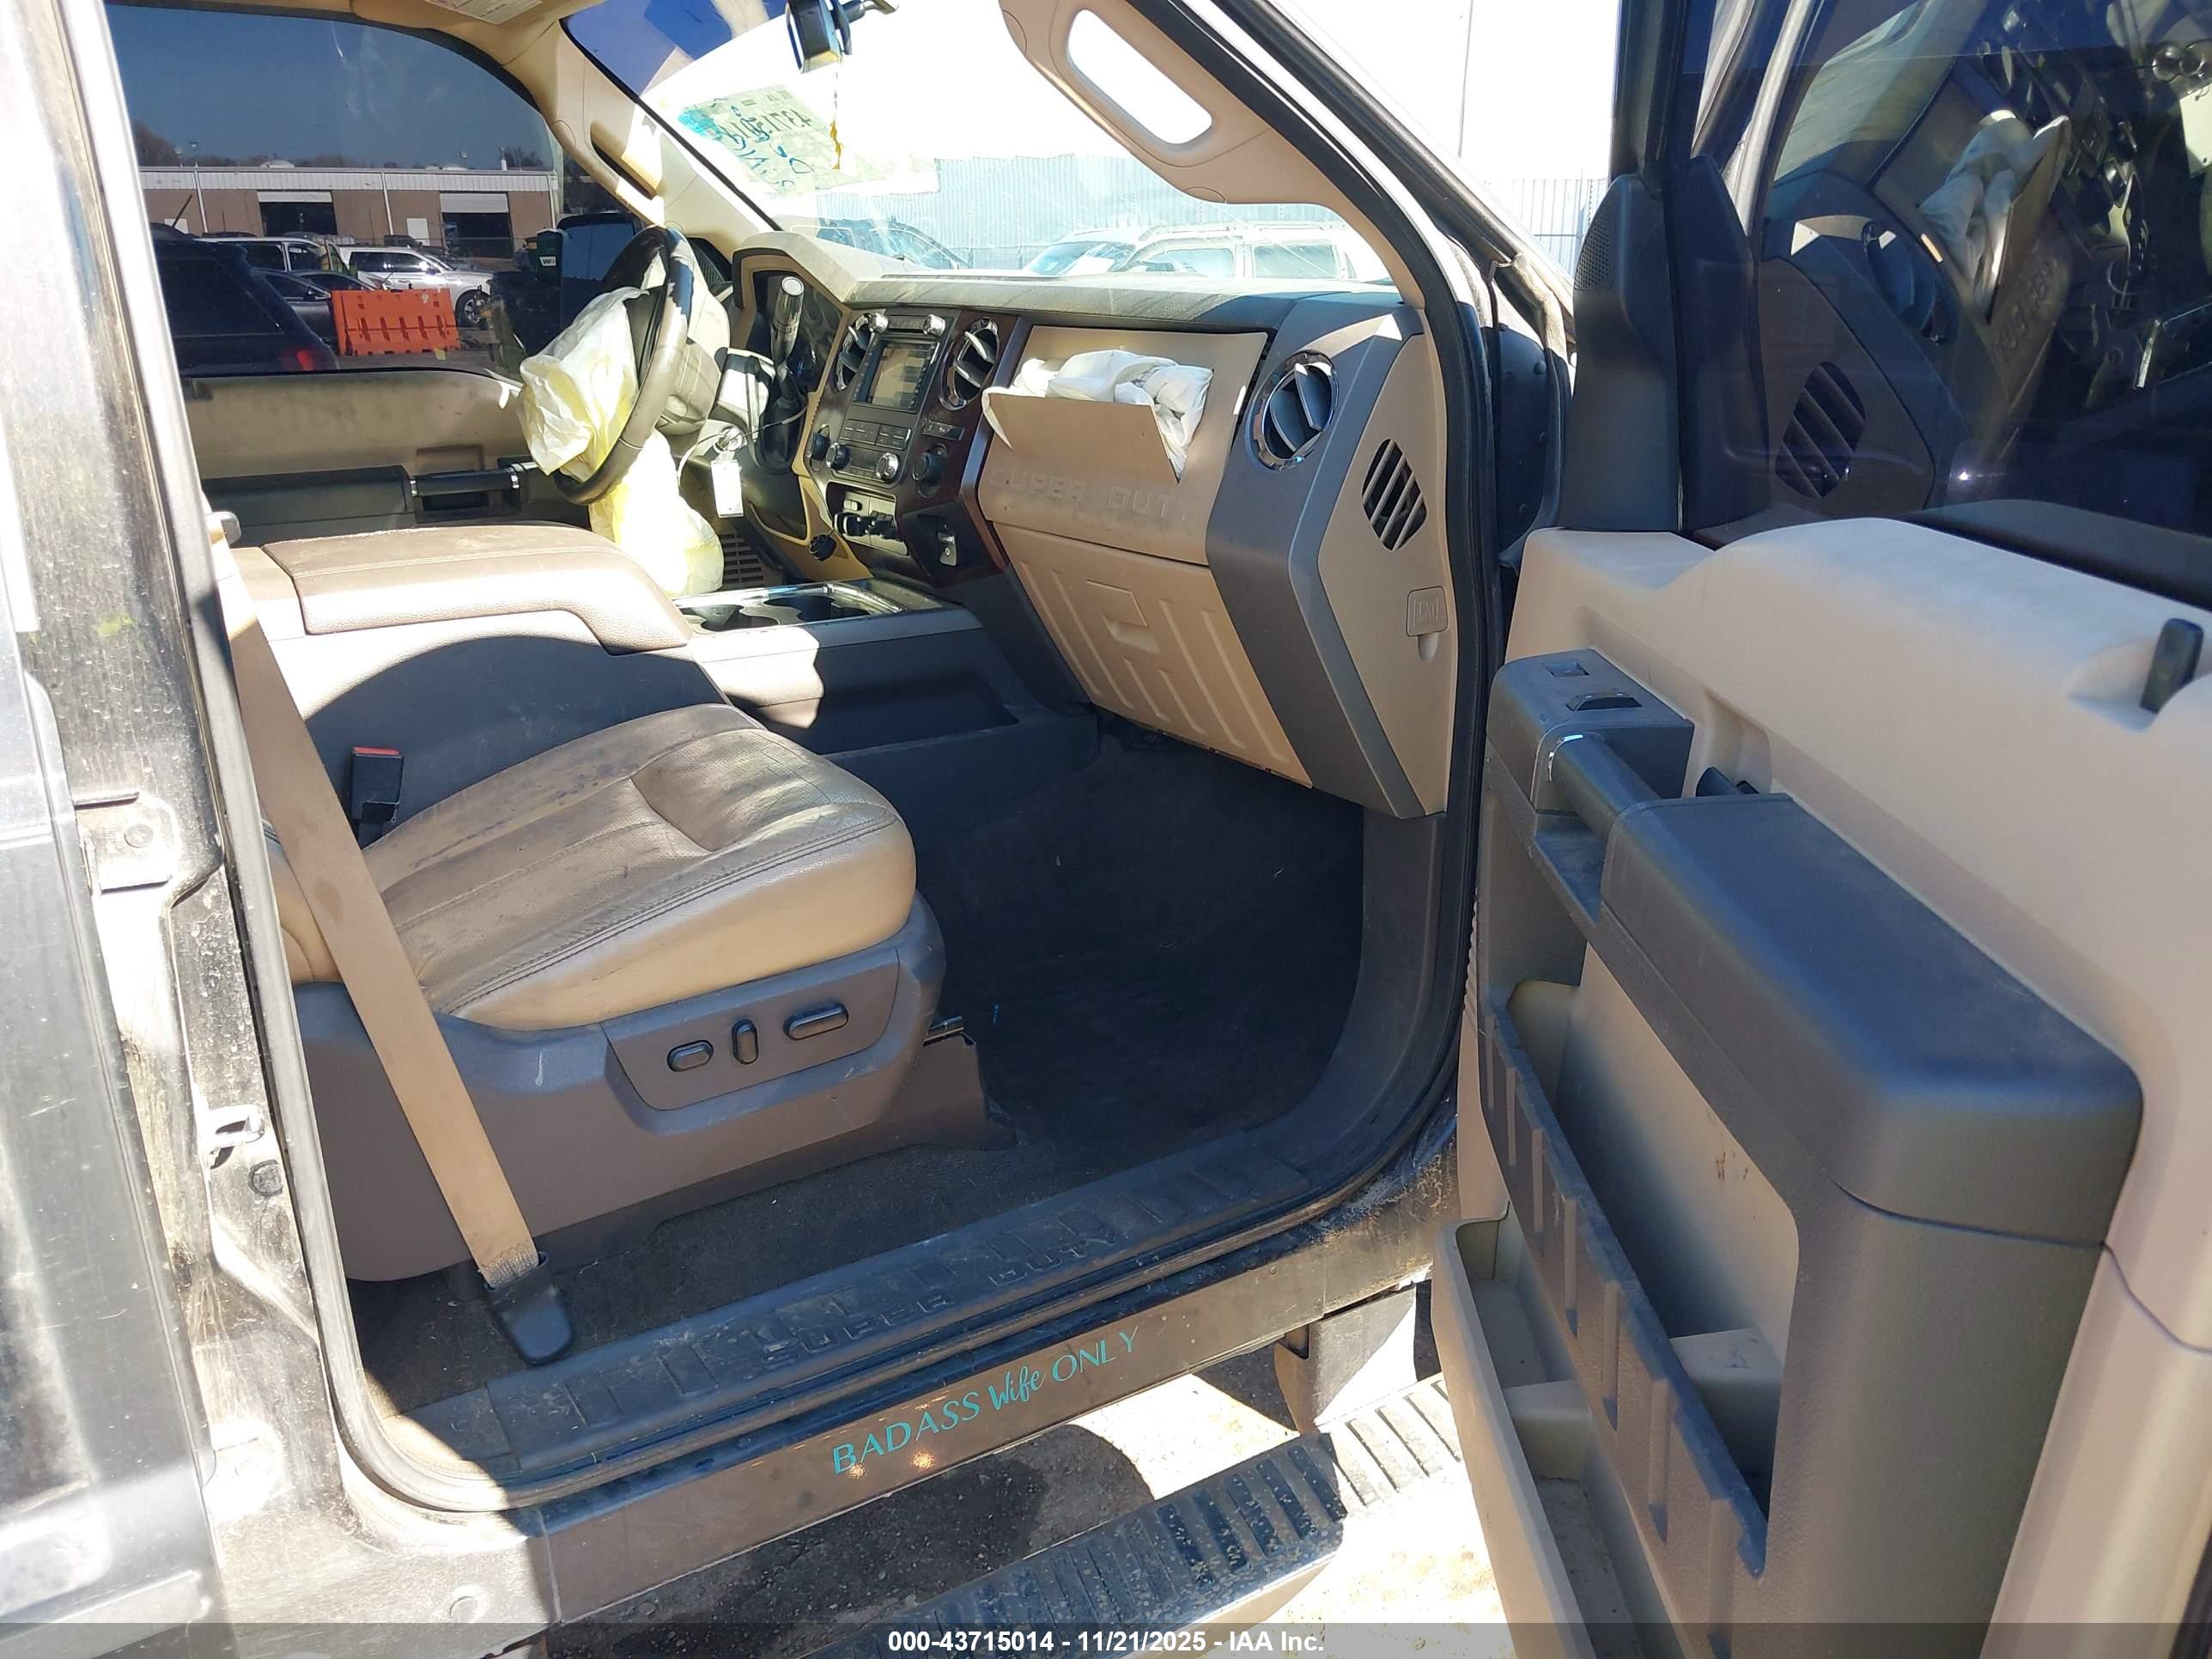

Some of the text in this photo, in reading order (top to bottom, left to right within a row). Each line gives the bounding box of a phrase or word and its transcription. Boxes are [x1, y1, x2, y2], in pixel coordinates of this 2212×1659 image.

[989, 1231, 1116, 1286] DUTY
[833, 1326, 1139, 1474] BADASS Wife ONLY
